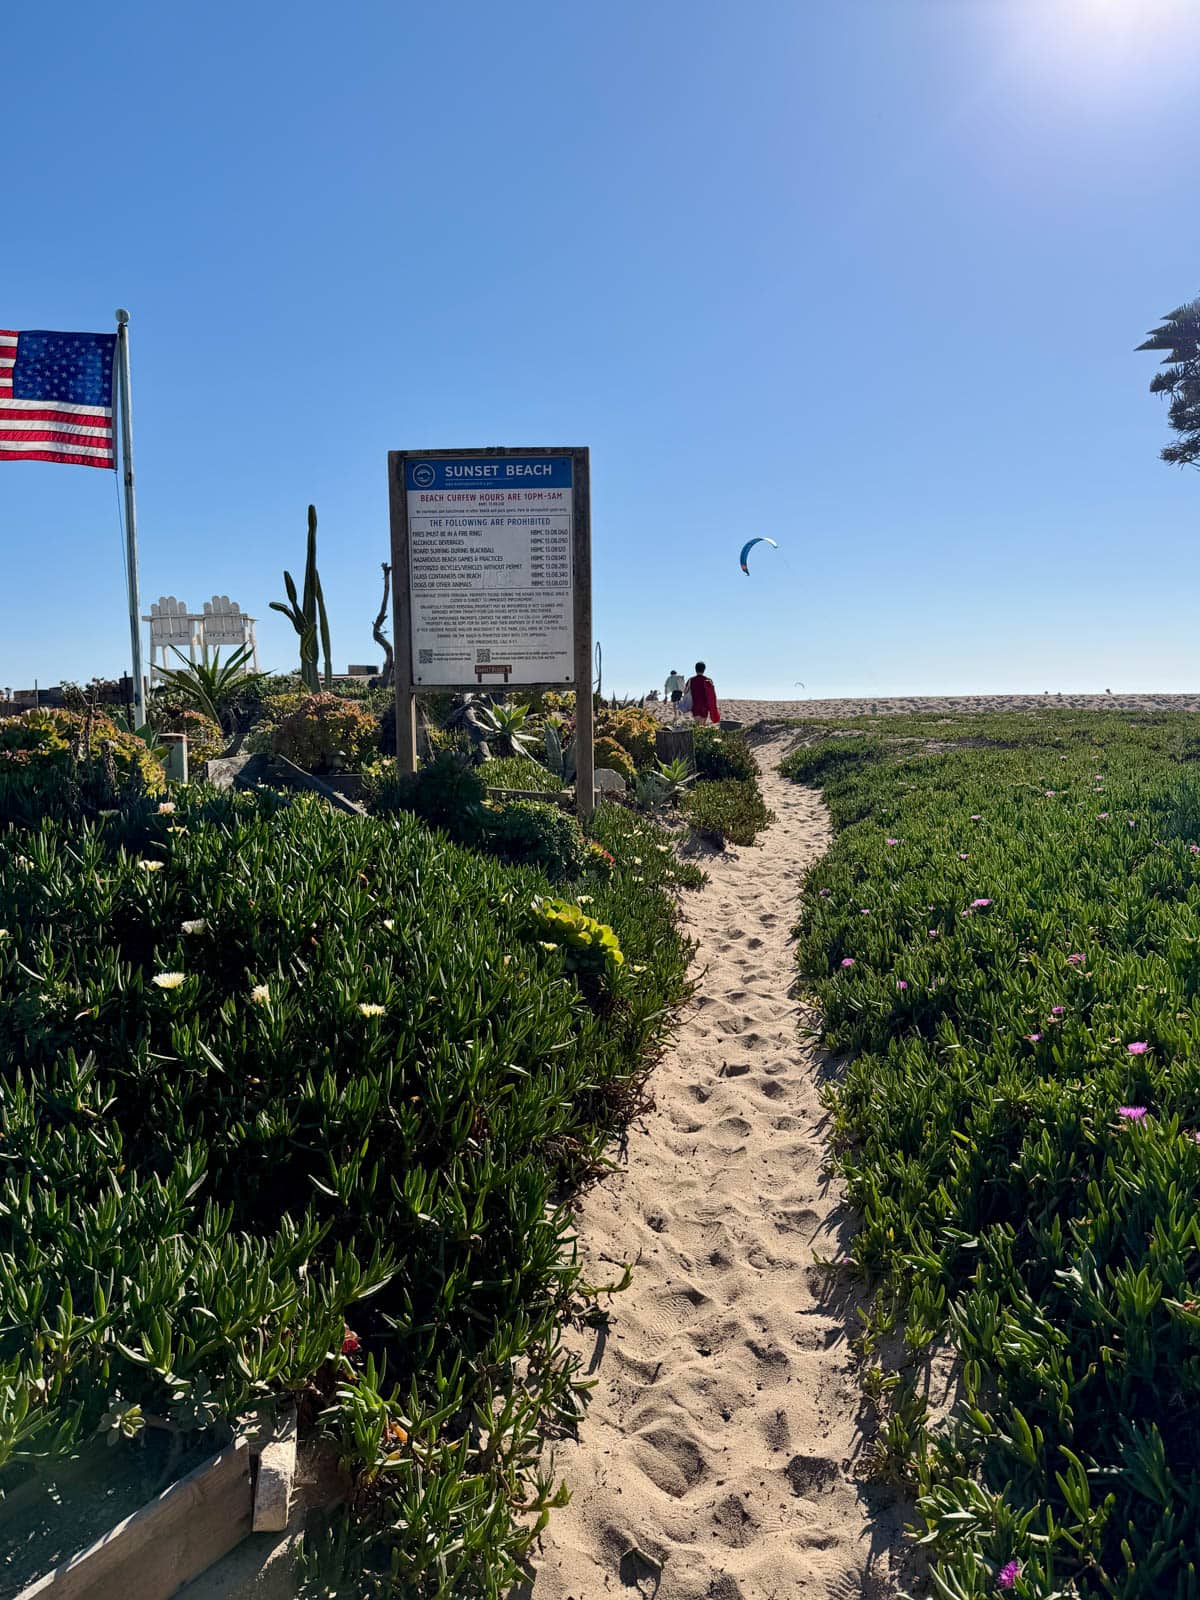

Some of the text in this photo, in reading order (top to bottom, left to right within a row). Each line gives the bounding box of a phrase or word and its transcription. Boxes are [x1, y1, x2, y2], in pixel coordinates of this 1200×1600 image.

[445, 465, 552, 477] SUNSET BEACH
[447, 494, 476, 502] CURFEW
[479, 493, 504, 501] HOURS
[508, 493, 520, 501] ARE
[524, 492, 562, 501] 10PM-5AM
[507, 518, 551, 526] PROHIBITED
